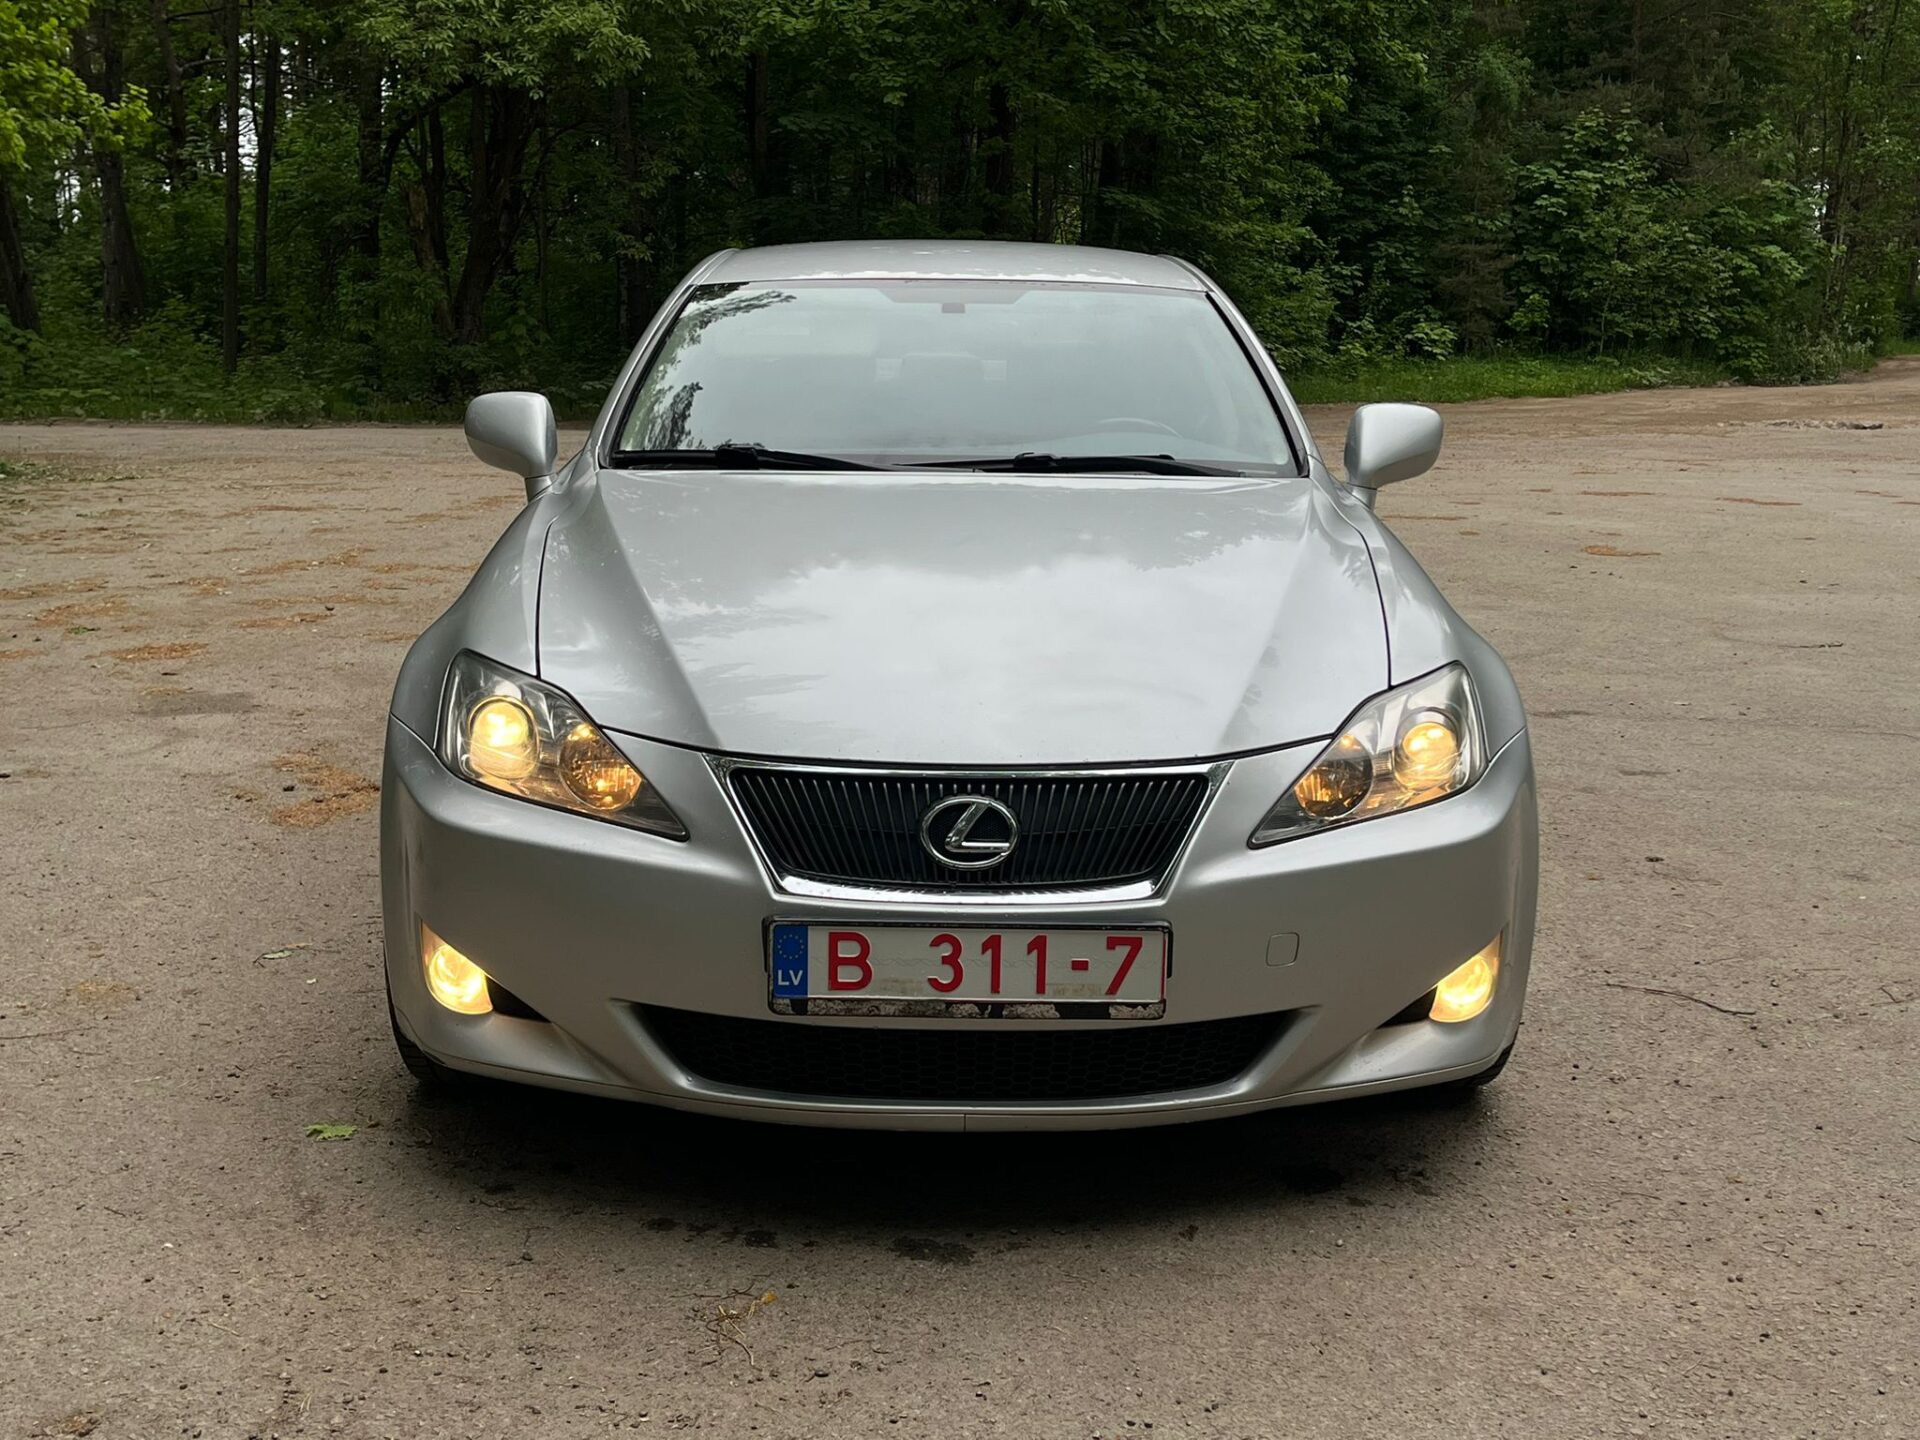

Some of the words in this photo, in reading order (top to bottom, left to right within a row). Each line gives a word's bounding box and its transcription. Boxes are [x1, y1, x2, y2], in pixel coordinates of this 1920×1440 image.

[777, 969, 803, 986] LV
[828, 931, 873, 991] B
[927, 933, 1144, 995] 311-7
